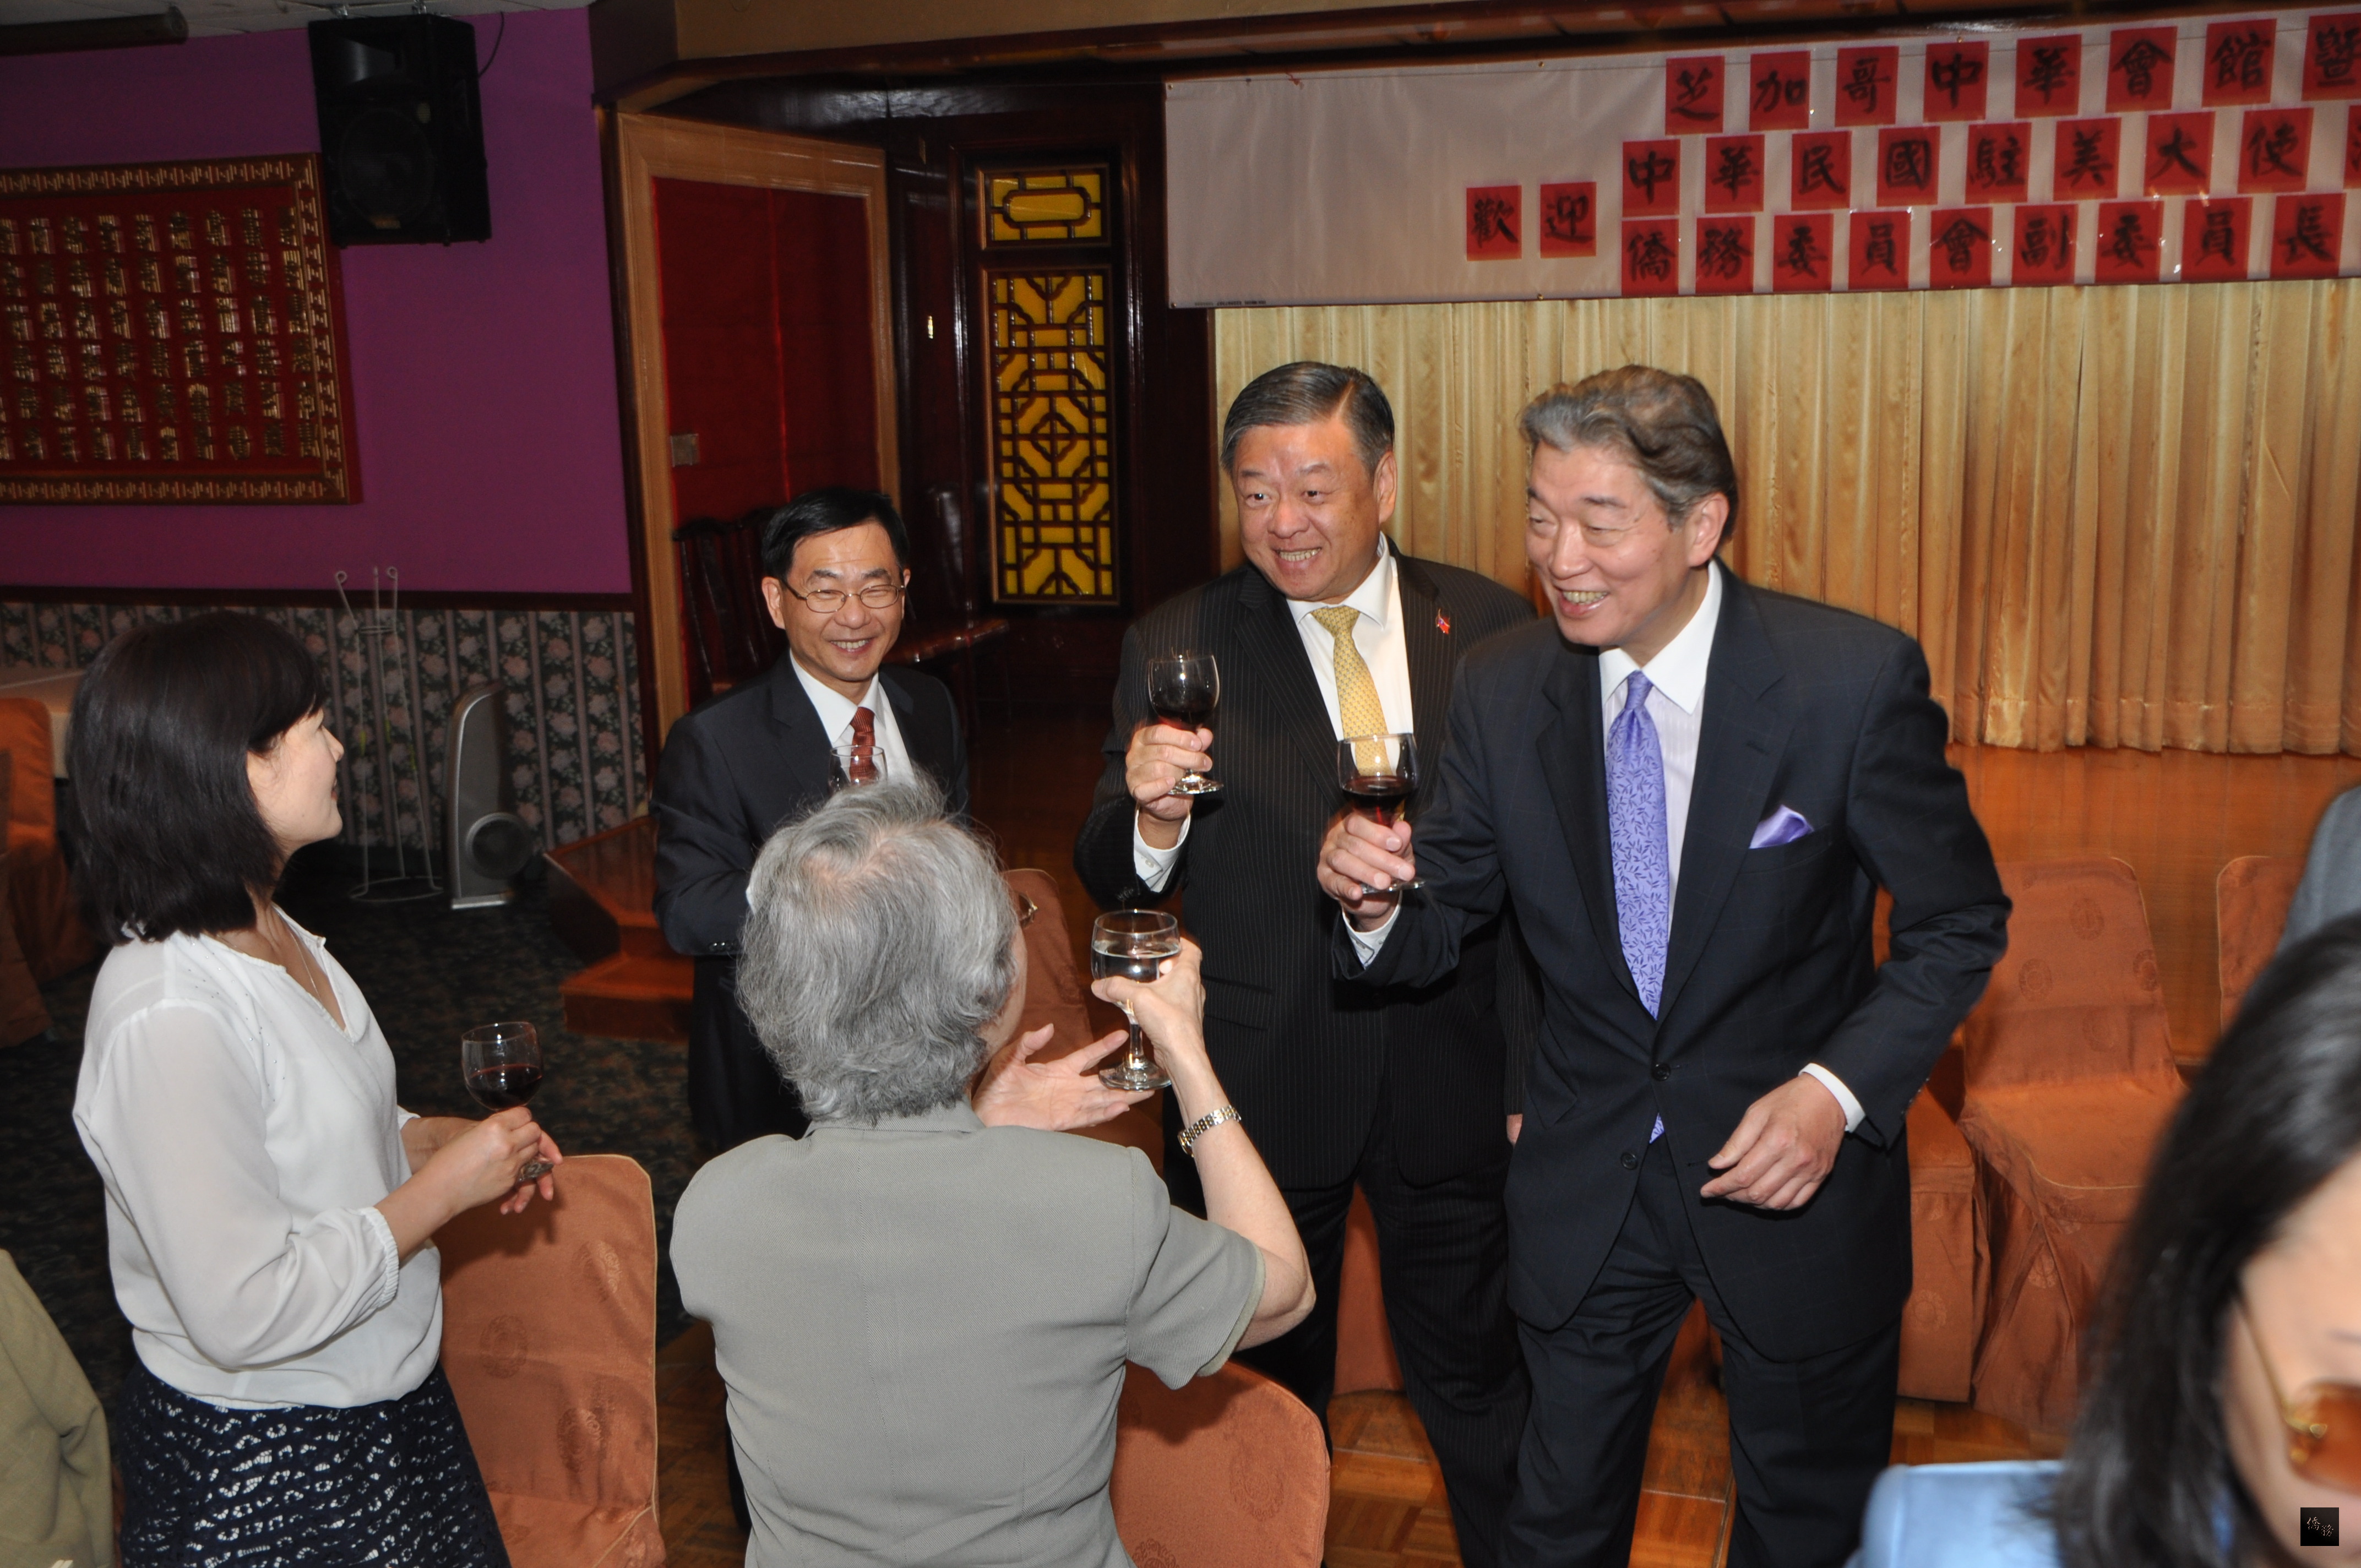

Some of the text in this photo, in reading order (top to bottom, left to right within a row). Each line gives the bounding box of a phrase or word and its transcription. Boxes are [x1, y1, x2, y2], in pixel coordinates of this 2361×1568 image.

[1471, 196, 1593, 248] 歡迎
[1627, 205, 2336, 282] 僑務委員會副委員長
